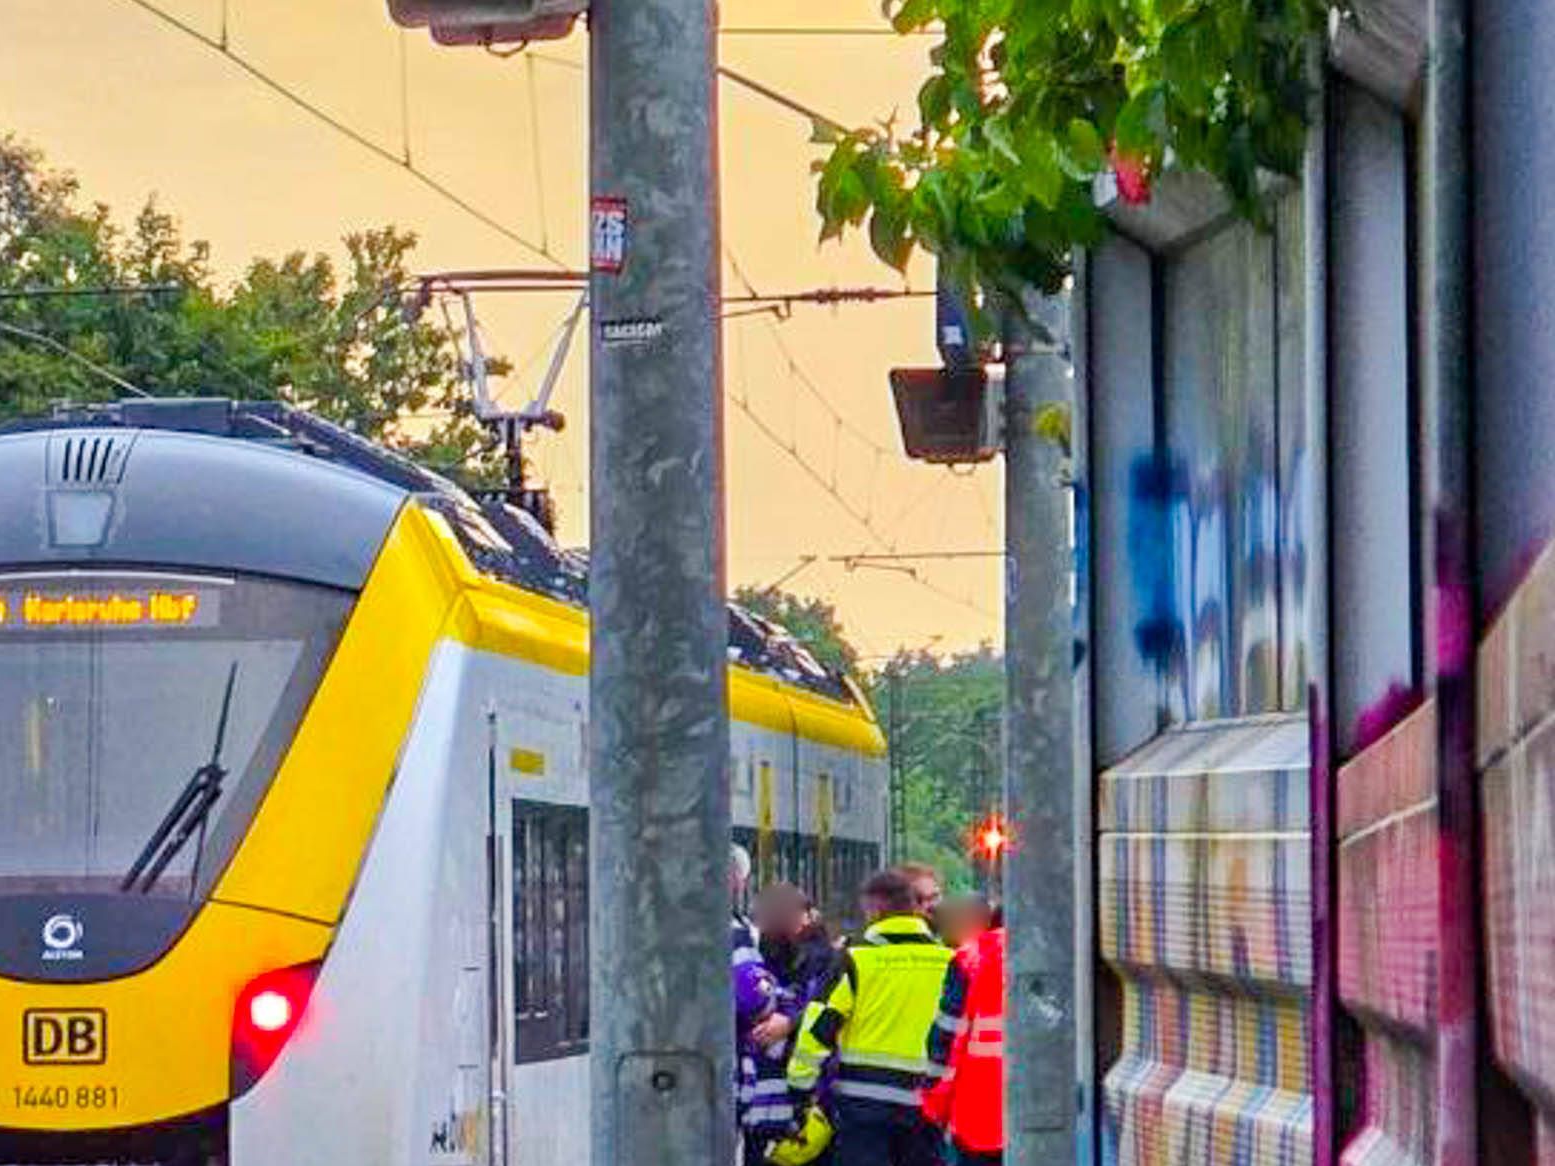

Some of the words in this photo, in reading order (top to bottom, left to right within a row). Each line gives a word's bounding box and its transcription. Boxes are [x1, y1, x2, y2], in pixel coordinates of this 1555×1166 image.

[24, 595, 142, 622] Karlsruhe
[150, 594, 196, 620] Hbf
[30, 1014, 99, 1058] DB
[12, 1086, 69, 1109] 1440
[75, 1086, 120, 1109] 881
